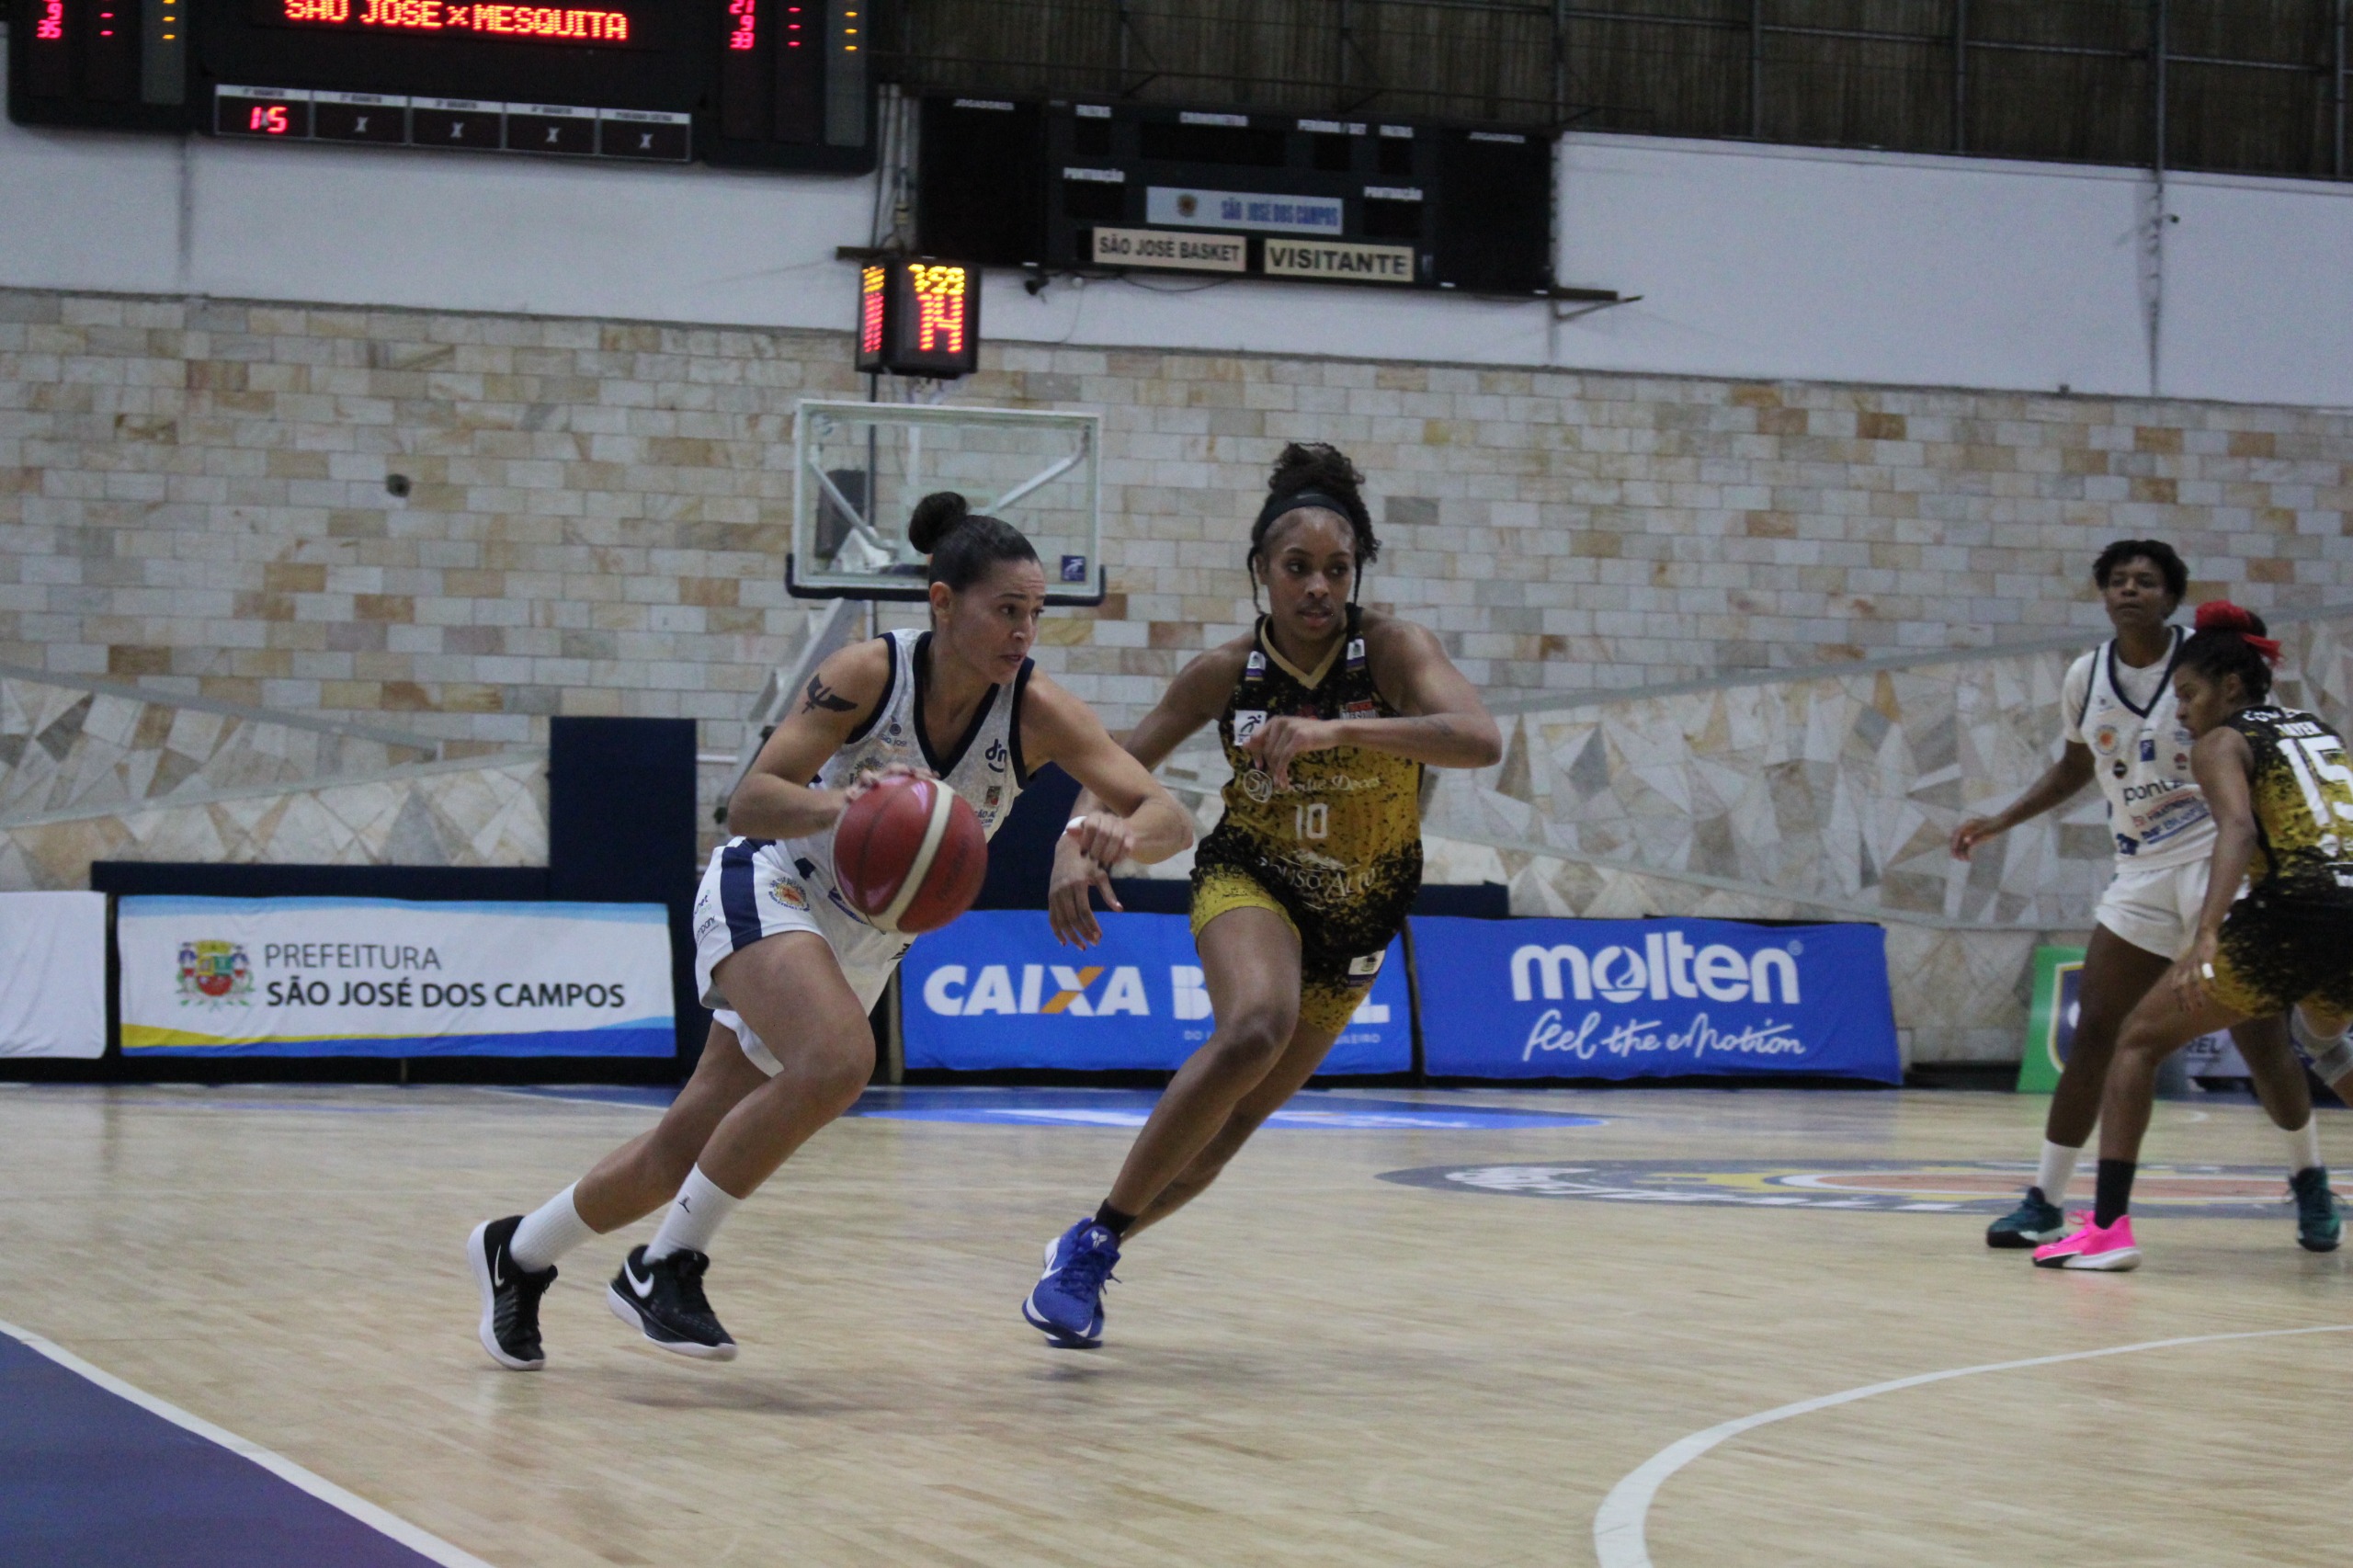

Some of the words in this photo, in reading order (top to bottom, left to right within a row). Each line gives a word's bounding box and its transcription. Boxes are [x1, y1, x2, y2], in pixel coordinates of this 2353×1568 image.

[472, 4, 627, 40] MESQUITA
[1098, 232, 1131, 256] SÃO
[1135, 234, 1174, 258] JOSÉ
[1180, 240, 1241, 263] BASKET
[1269, 246, 1406, 276] VISITANTE
[2277, 734, 2353, 827] 15
[1296, 802, 1327, 839] 10
[265, 942, 441, 971] PREFEITURA
[1510, 931, 1801, 1005] molten
[267, 974, 330, 1007] SÃO
[339, 976, 412, 1007] JOSÉ
[423, 983, 486, 1008] DOS
[494, 982, 625, 1008] CAMPOS
[923, 964, 1151, 1017] CAIXA
[1522, 1009, 1601, 1062] feel
[1600, 1019, 1662, 1058] the
